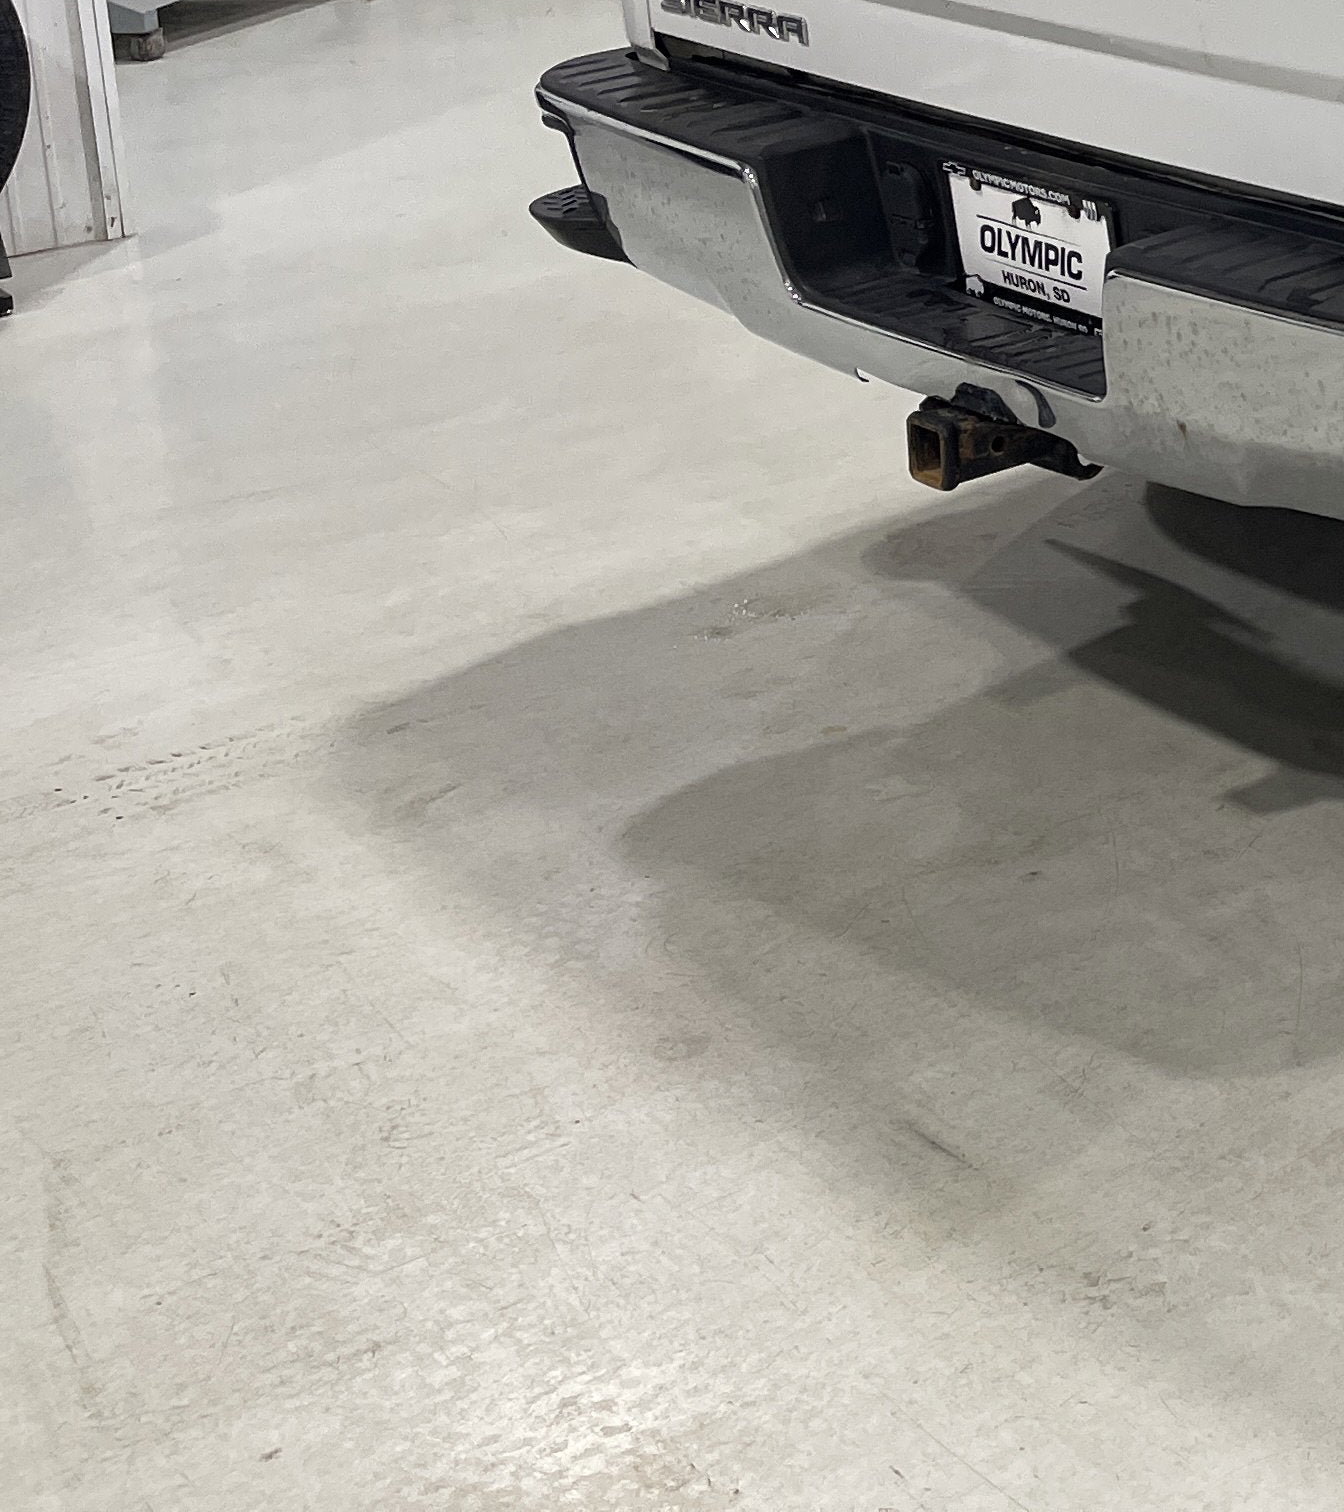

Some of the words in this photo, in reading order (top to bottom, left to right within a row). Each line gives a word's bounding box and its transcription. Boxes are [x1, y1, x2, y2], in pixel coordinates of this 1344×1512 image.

[980, 224, 1083, 281] OLYMPIC
[1002, 270, 1050, 300] HURON,
[1053, 286, 1070, 303] SD
